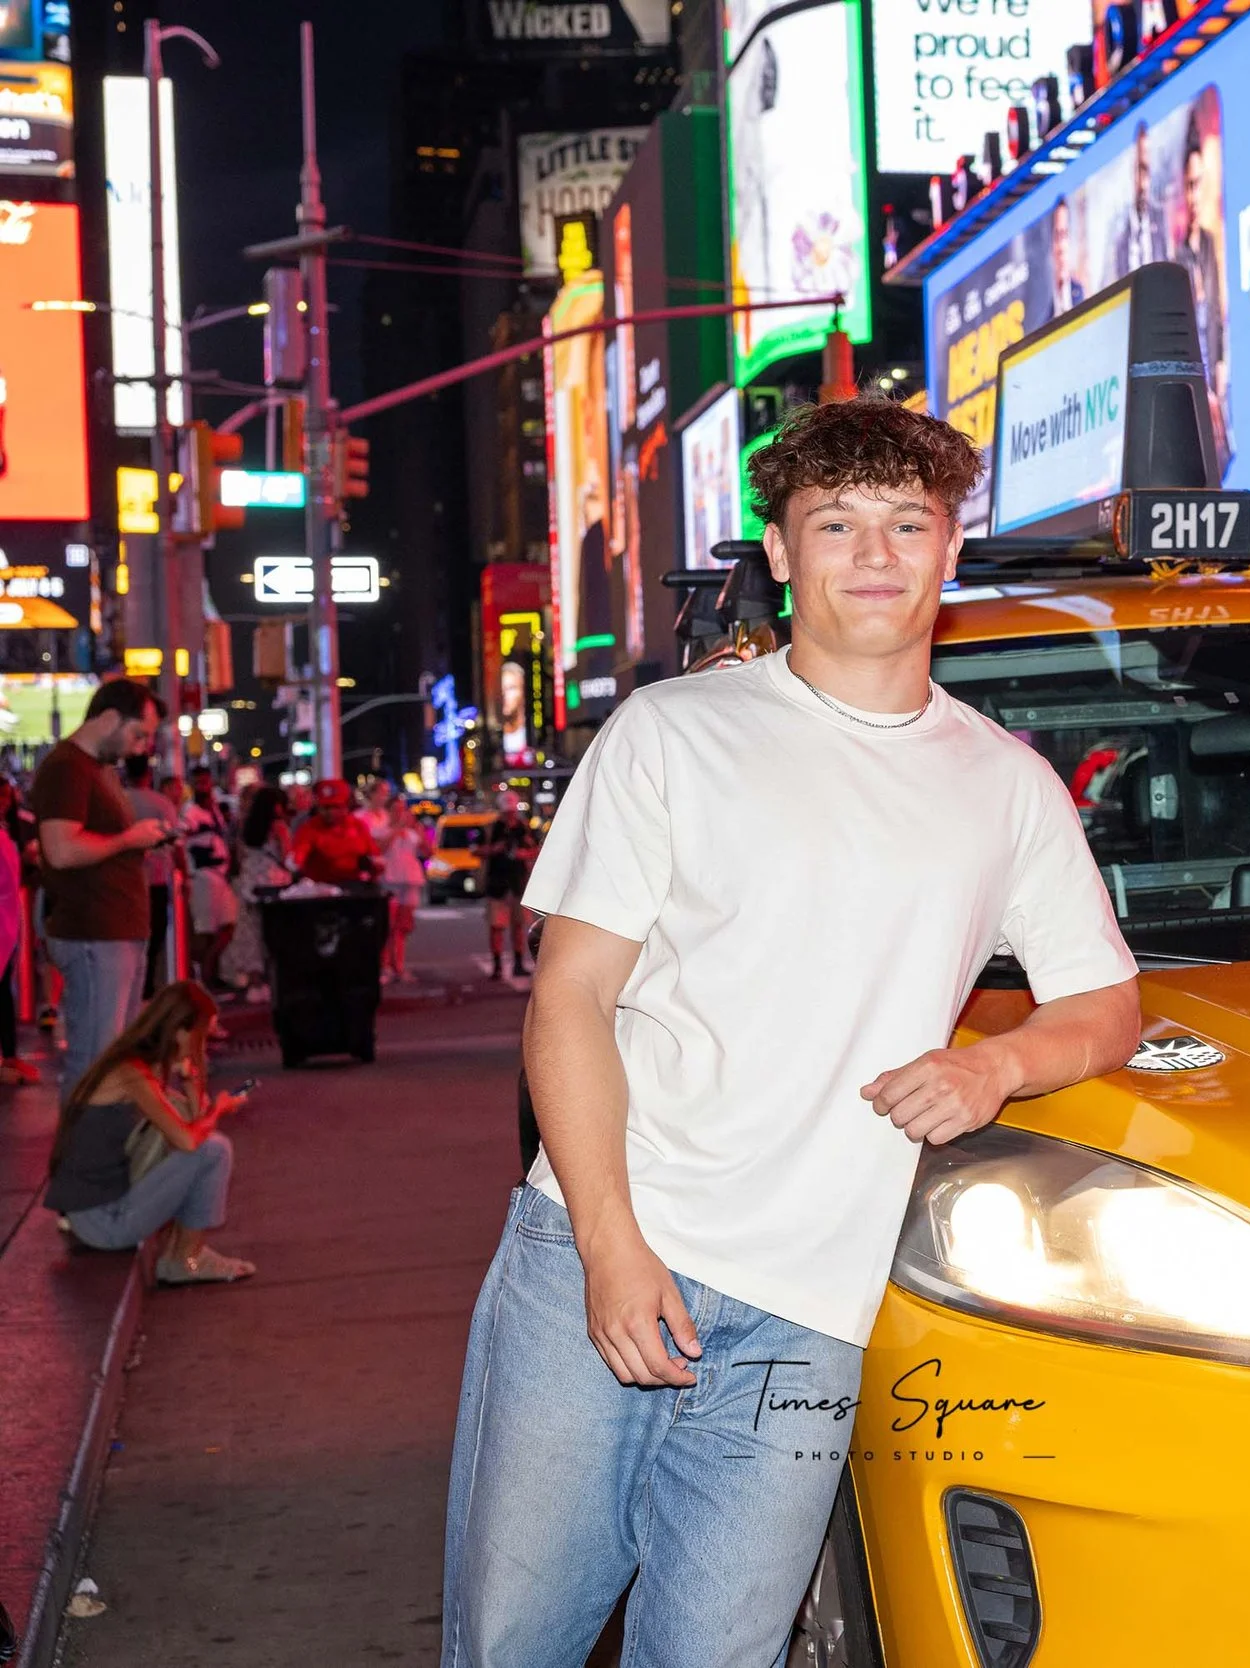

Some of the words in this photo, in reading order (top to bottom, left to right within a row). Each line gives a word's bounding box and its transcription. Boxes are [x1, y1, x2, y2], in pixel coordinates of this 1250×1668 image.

[914, 27, 1030, 62] proud
[914, 70, 954, 100] to
[964, 65, 1052, 101] fee
[536, 134, 611, 181] LITTLE
[1010, 418, 1048, 466] Move
[1049, 392, 1082, 448] with
[1084, 375, 1120, 434] NYC
[1151, 502, 1240, 549] 2H17
